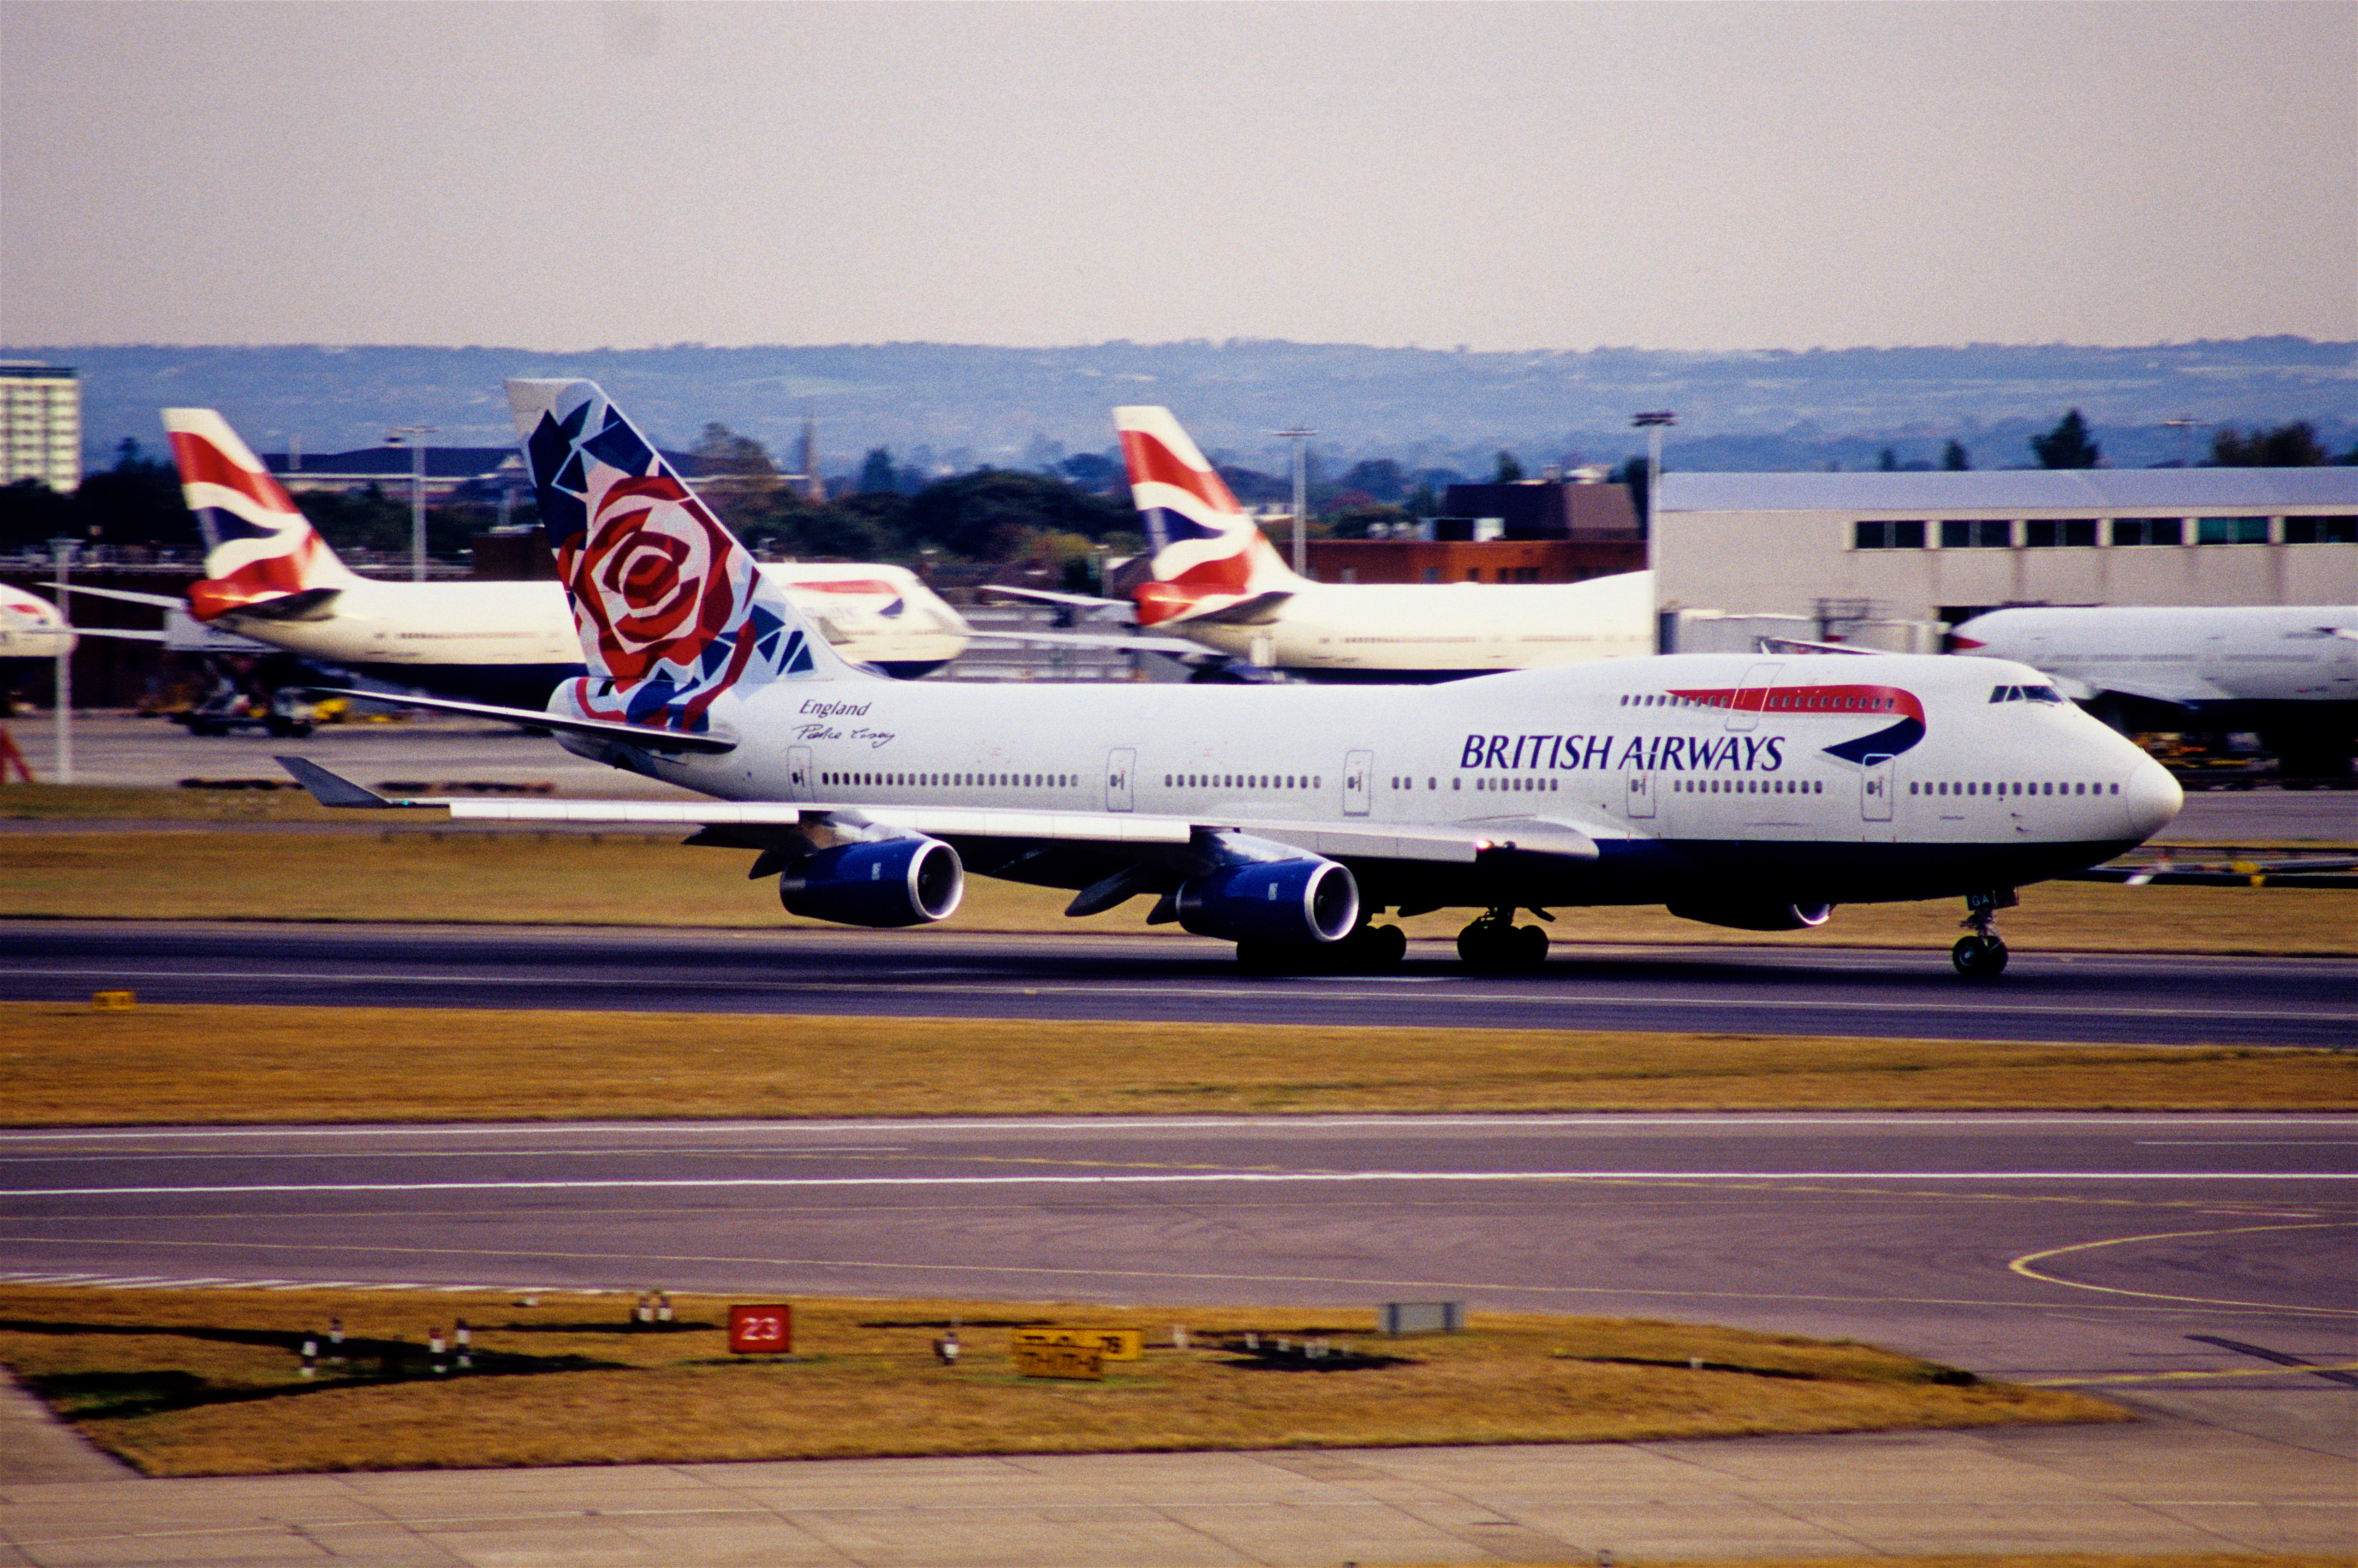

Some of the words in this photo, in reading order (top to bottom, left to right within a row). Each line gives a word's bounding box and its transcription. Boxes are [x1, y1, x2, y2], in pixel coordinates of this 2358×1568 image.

[799, 699, 872, 718] England
[1460, 735, 1614, 770] BRITISH
[1618, 736, 1786, 772] AIRWAYS
[740, 1317, 781, 1340] 23
